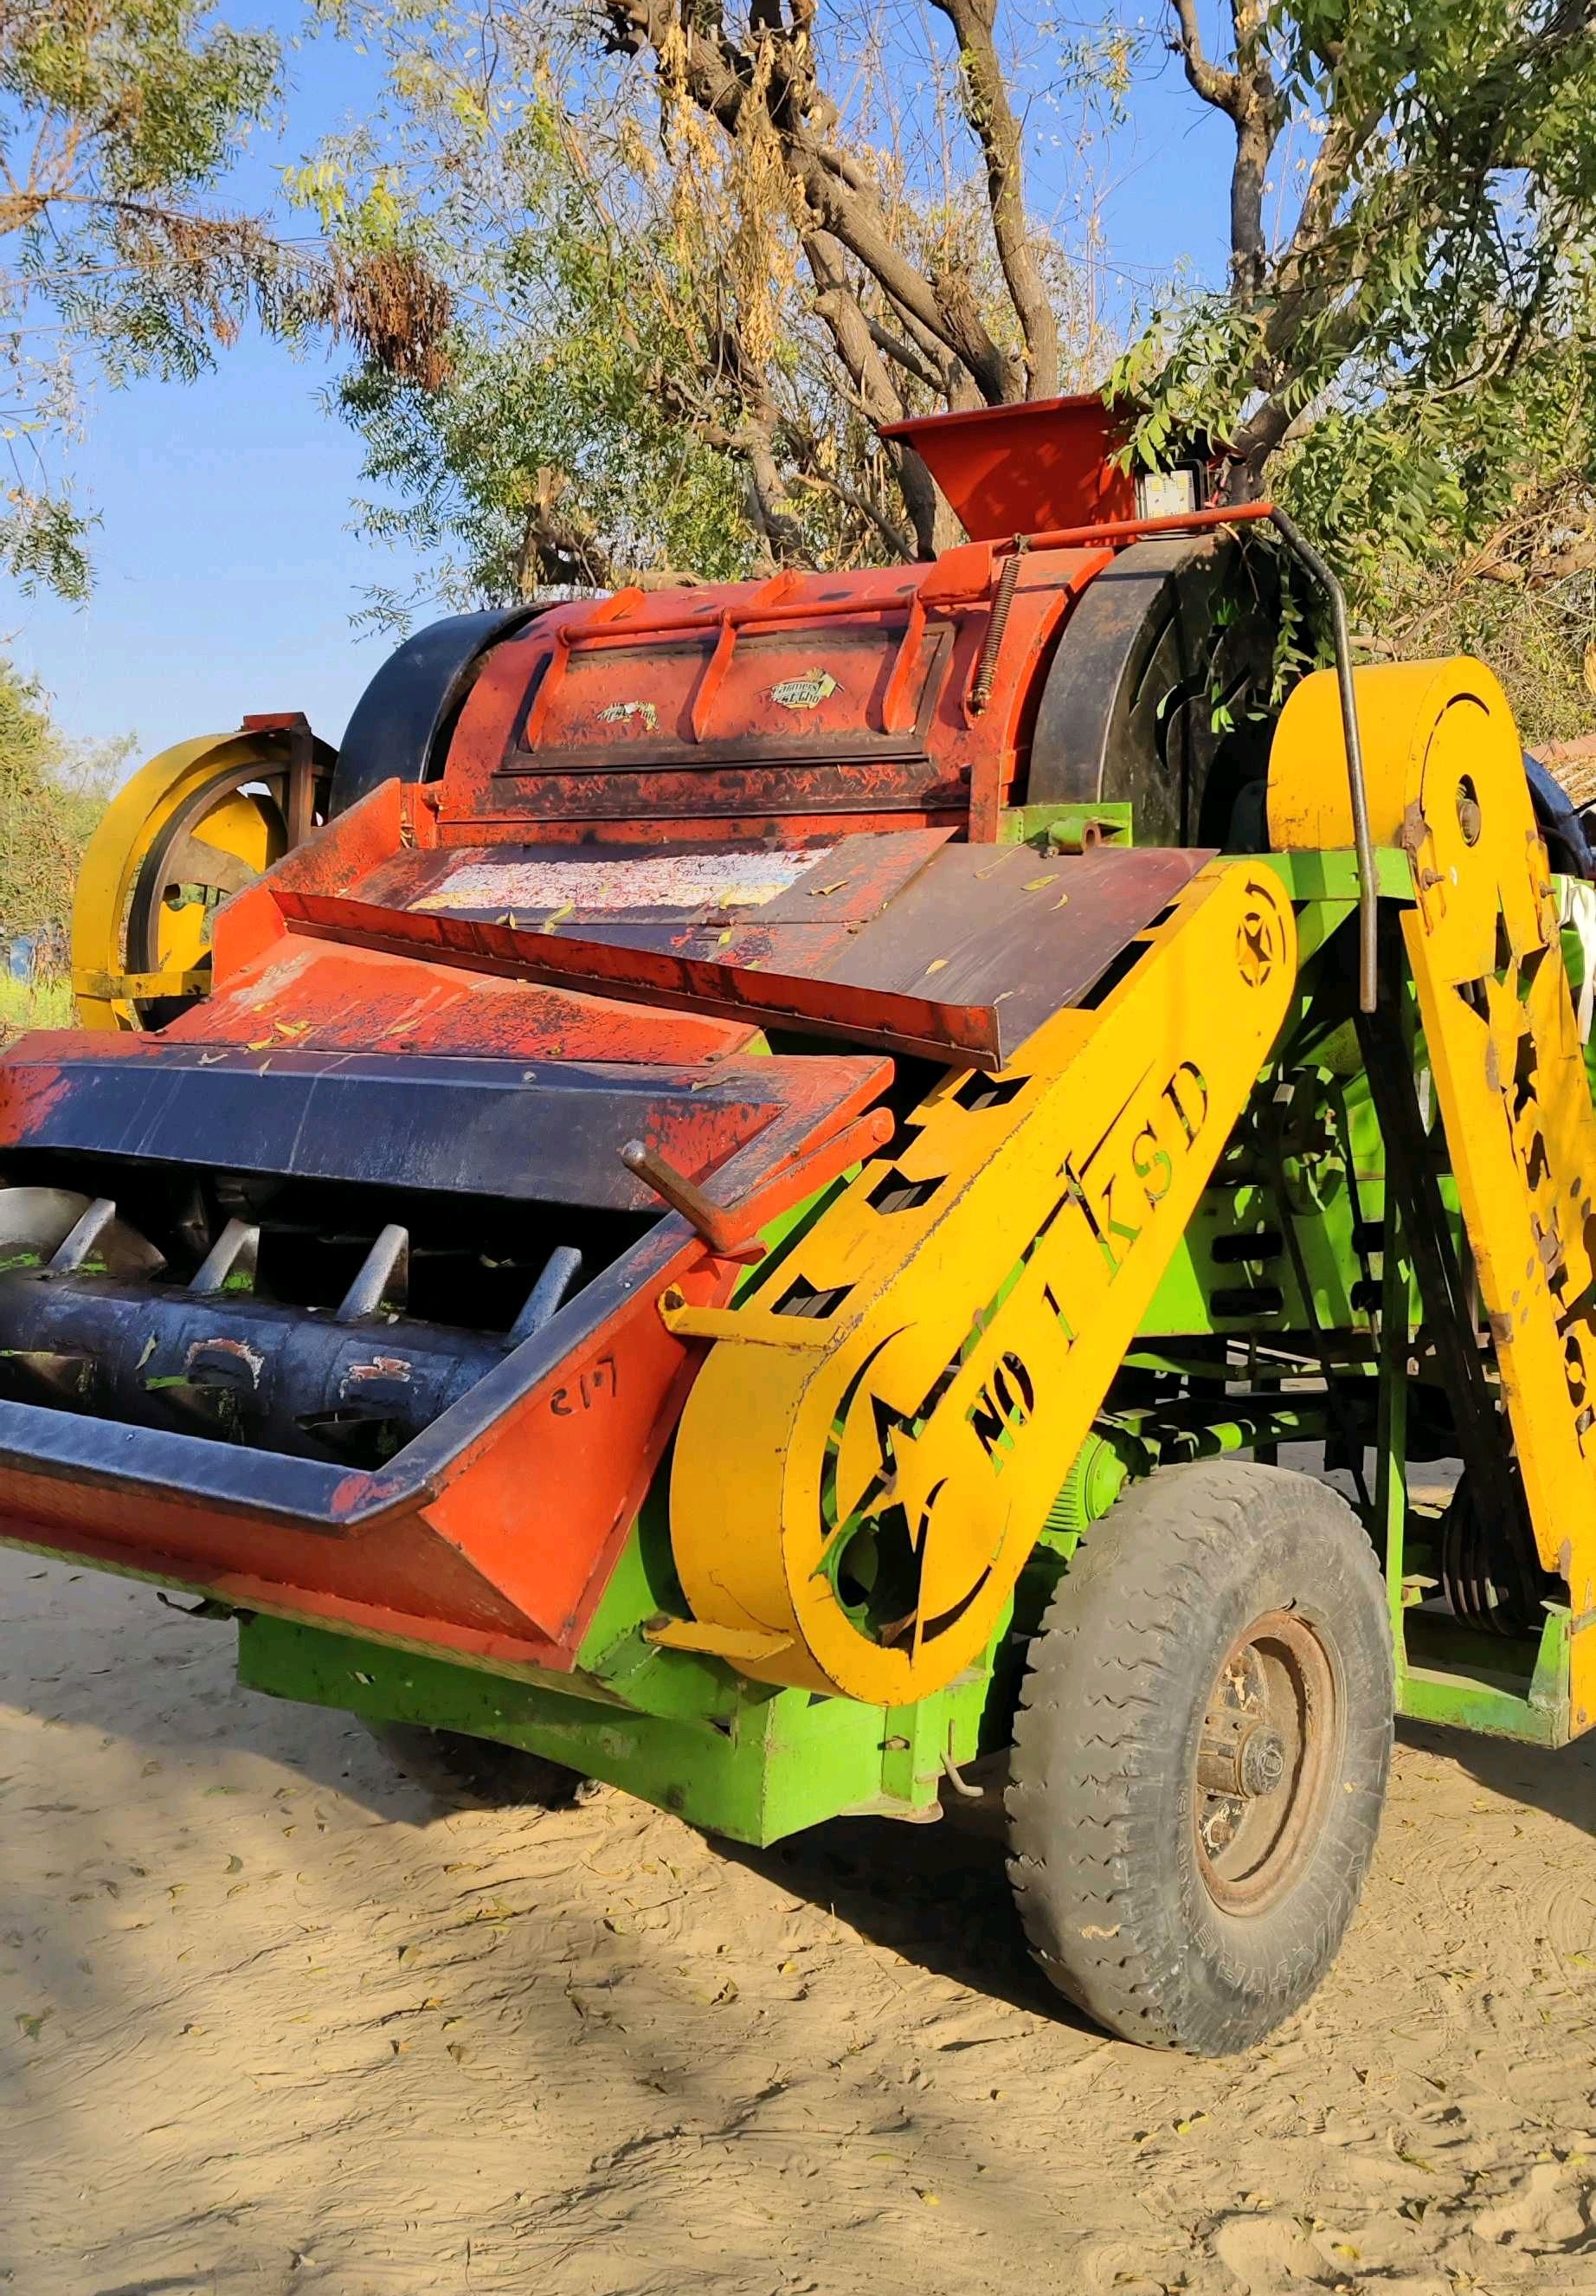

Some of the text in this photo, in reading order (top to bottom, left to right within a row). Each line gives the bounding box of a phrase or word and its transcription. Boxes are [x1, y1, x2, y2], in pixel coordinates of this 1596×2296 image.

[966, 1061, 1209, 1476] NO 1 KSD
